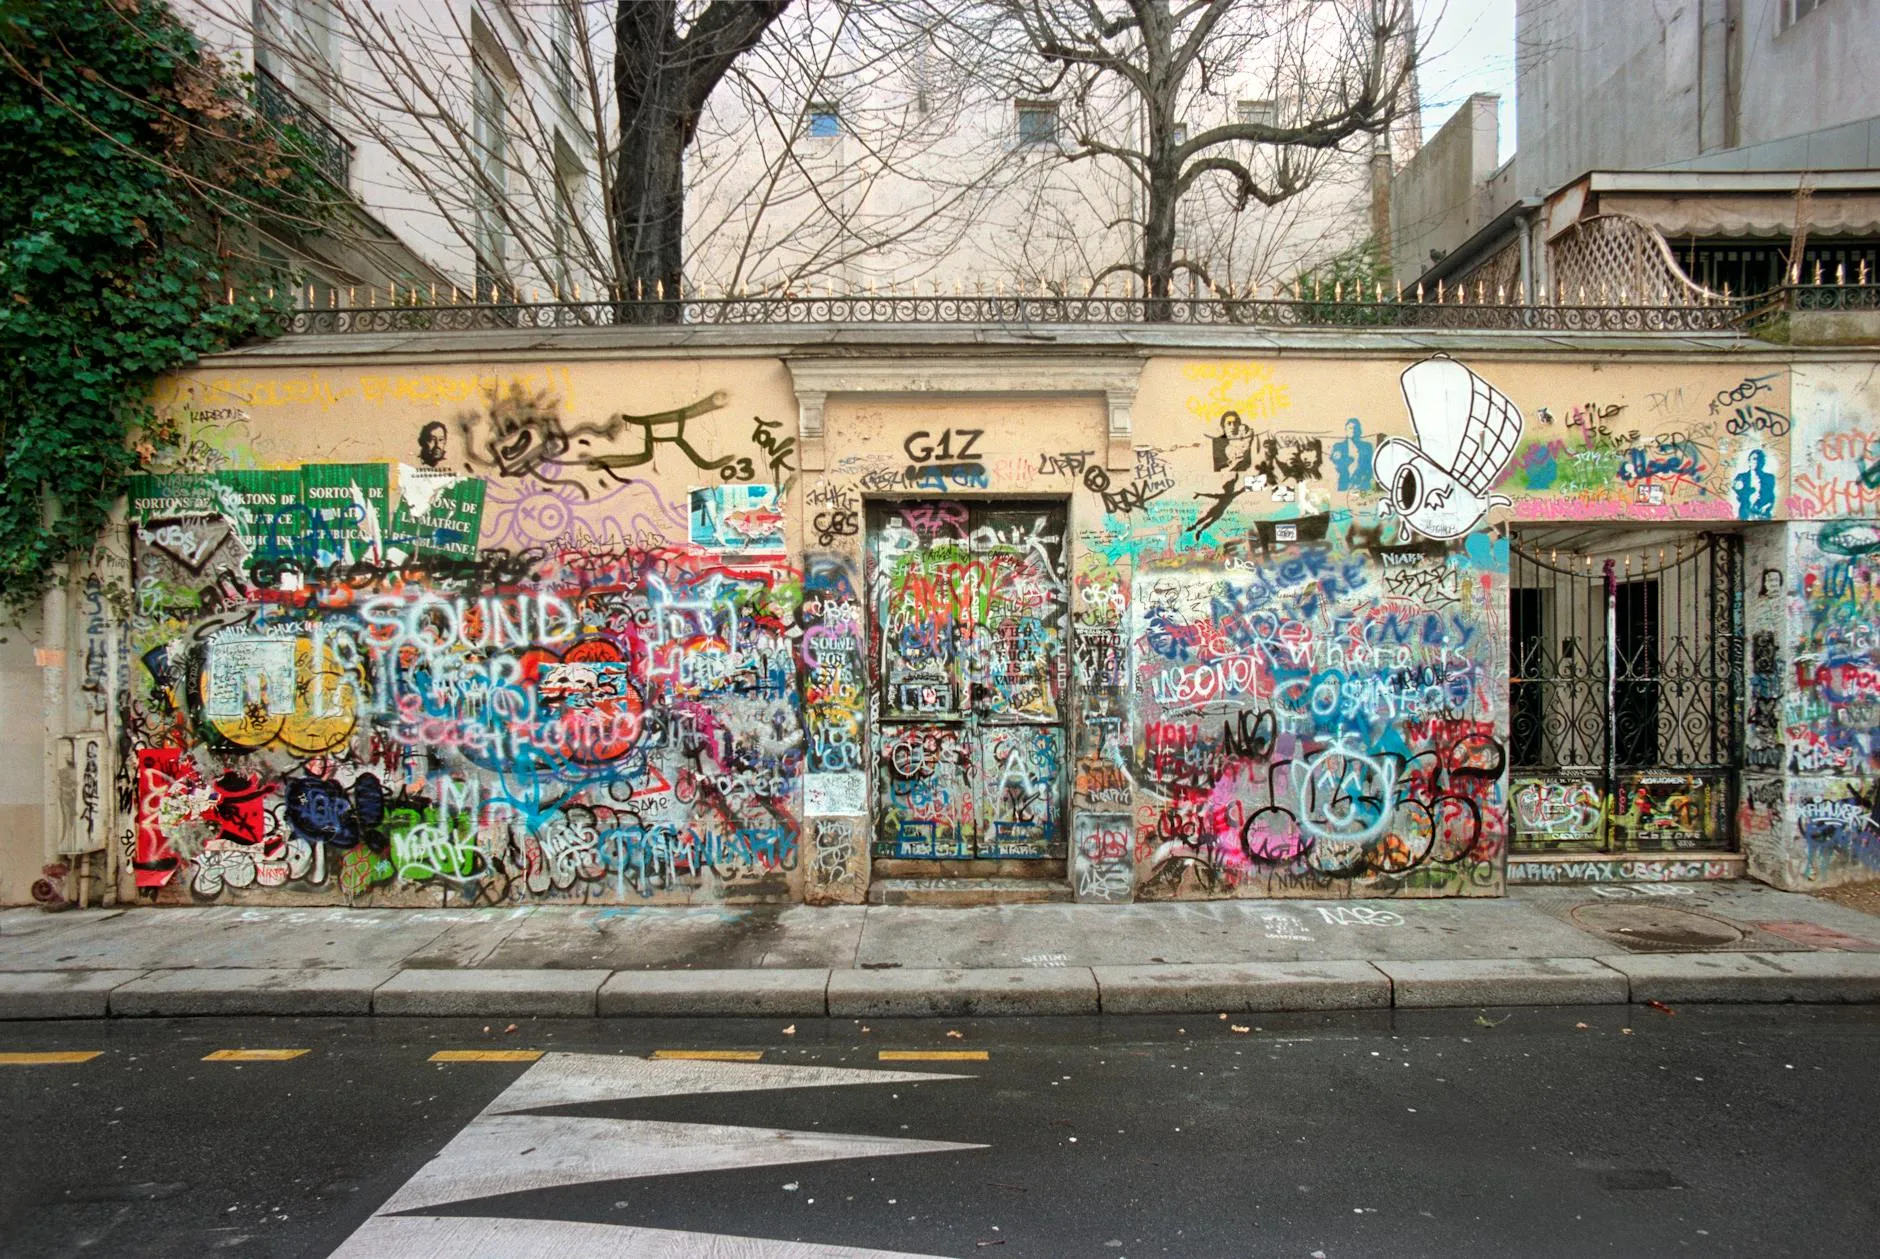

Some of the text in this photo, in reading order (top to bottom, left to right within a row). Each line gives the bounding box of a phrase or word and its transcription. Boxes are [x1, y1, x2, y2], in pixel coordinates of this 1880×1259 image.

[369, 487, 384, 498] DE
[281, 494, 297, 505] DE
[462, 503, 478, 514] DE
[420, 516, 472, 533] MATRICE
[360, 592, 579, 648] SOUND
